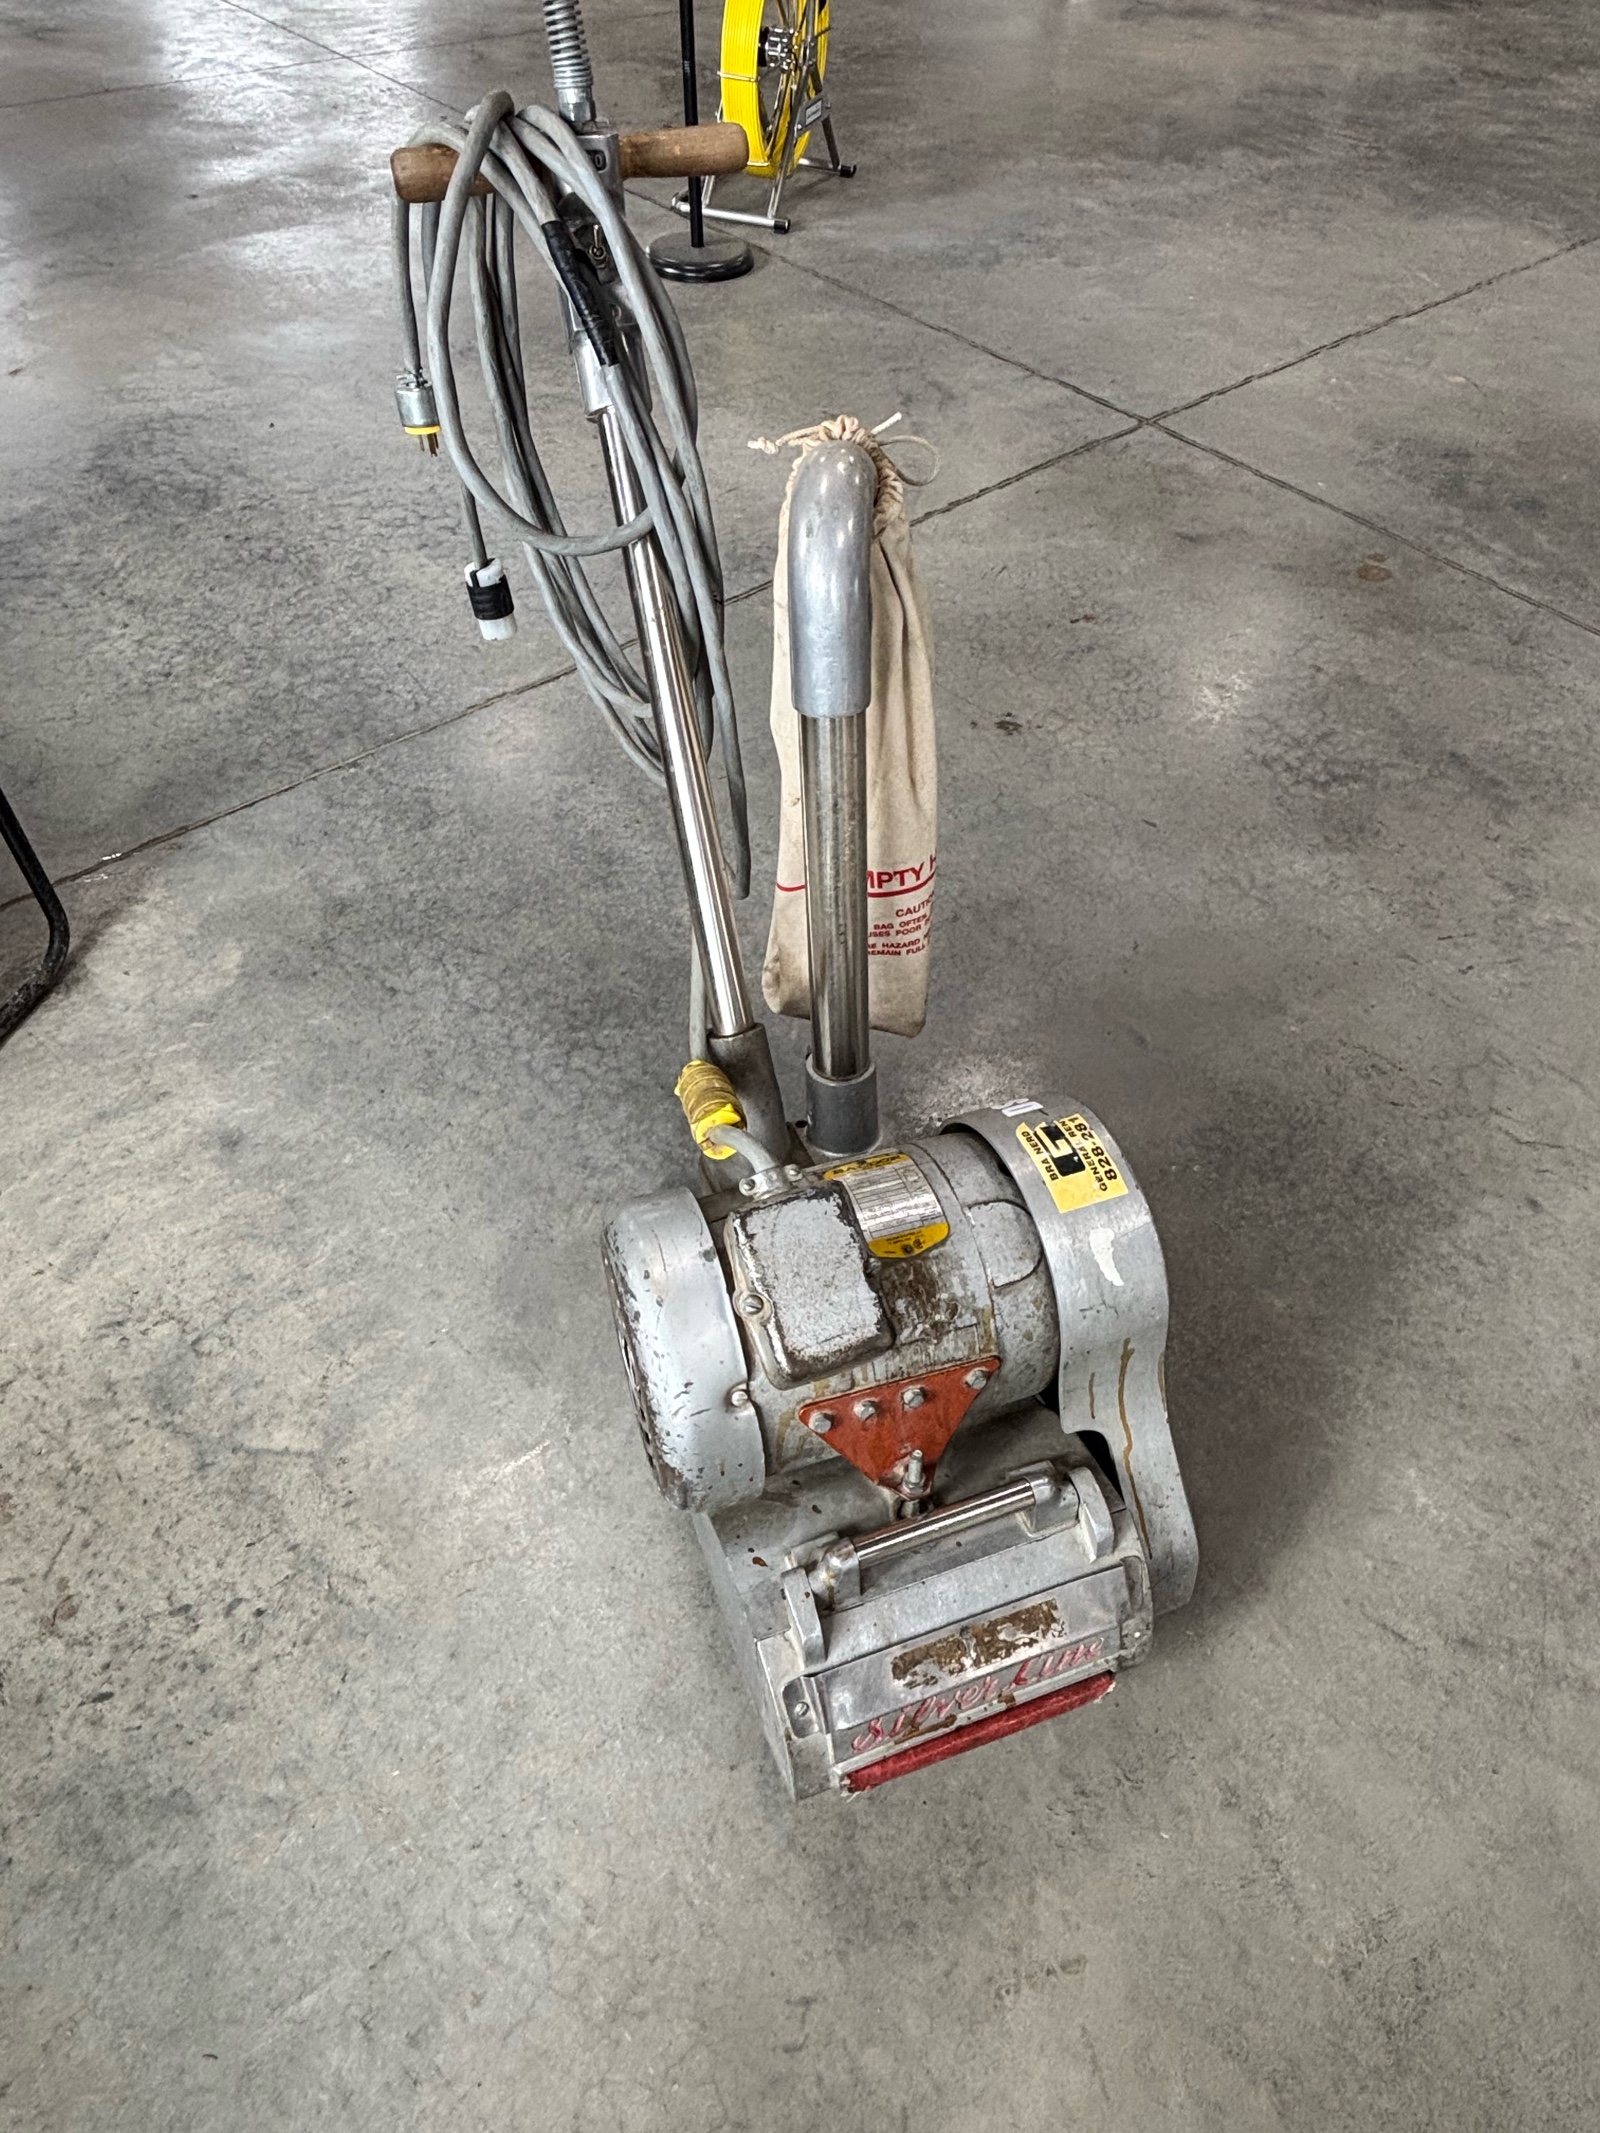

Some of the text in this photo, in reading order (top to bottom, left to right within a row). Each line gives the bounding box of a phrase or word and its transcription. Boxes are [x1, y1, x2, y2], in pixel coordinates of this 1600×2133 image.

[873, 922, 894, 931] BAG
[895, 924, 922, 936] POOR
[882, 938, 920, 949] HAZARD
